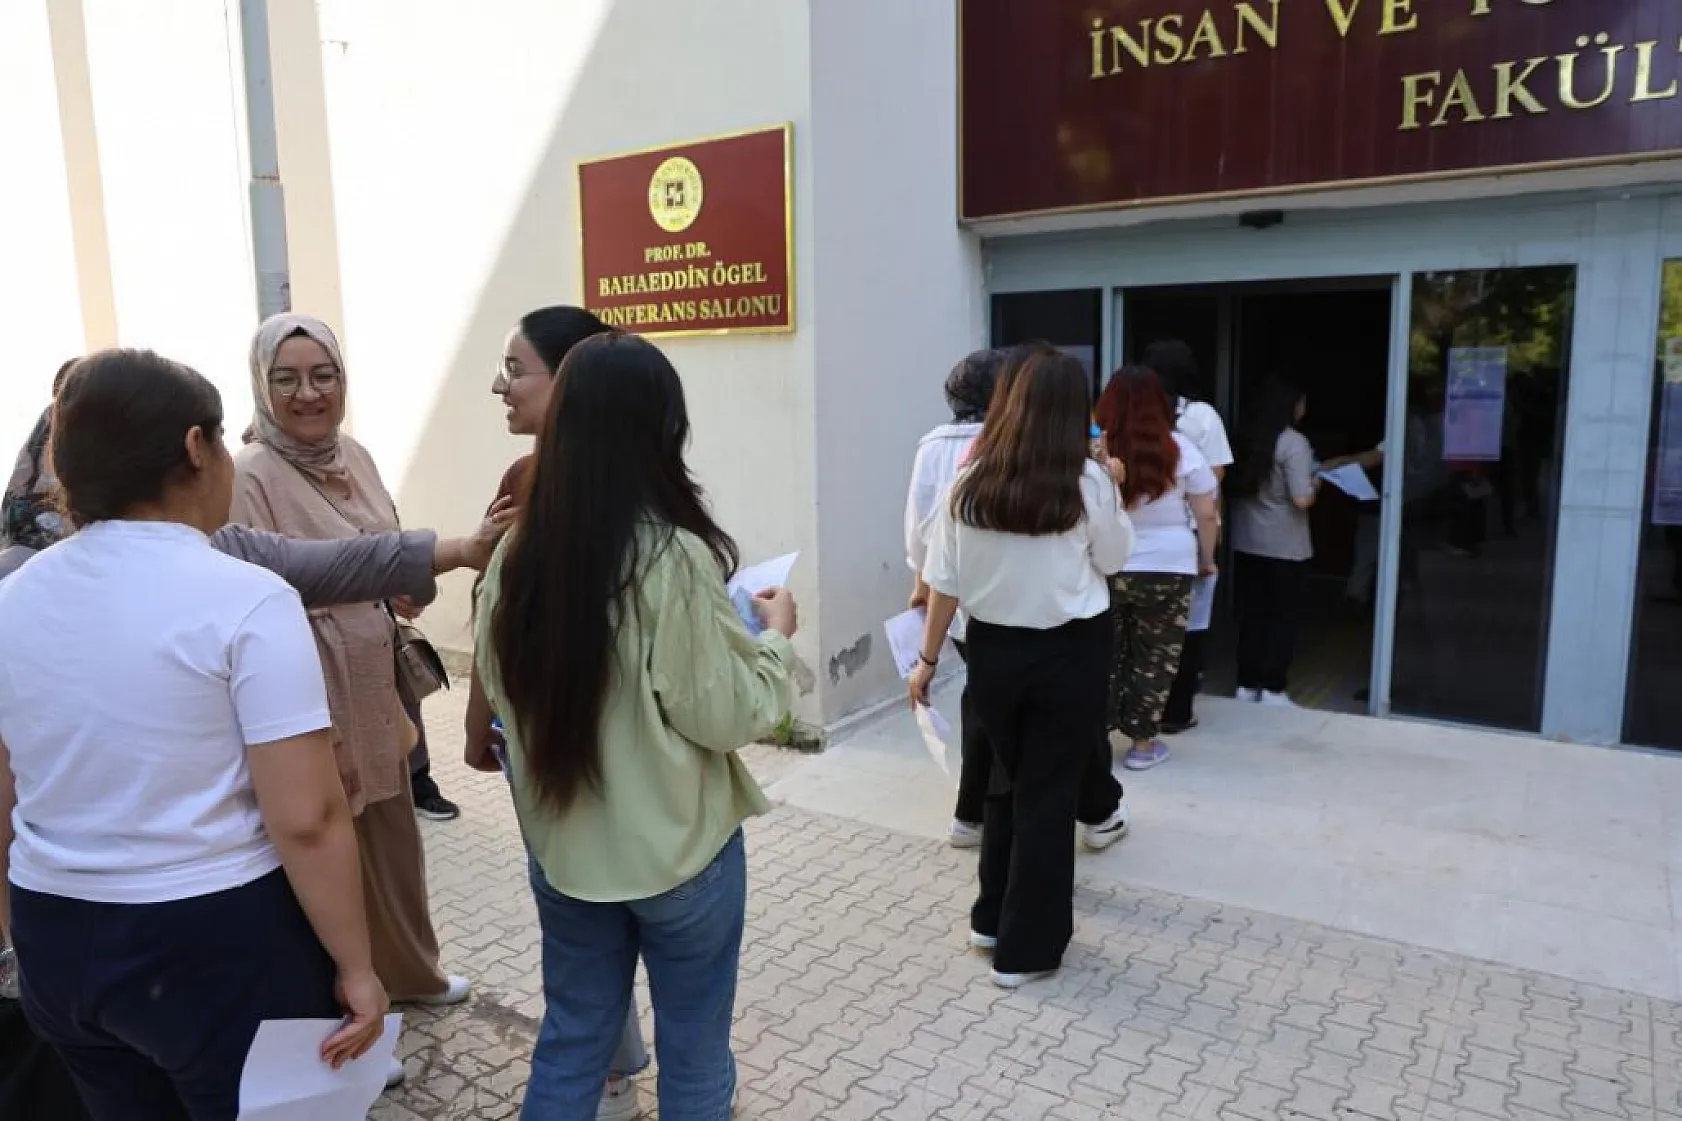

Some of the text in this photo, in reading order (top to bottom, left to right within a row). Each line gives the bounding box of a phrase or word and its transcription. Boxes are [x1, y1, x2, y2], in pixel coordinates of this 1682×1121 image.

[1089, 0, 1418, 79] İNSAN VE
[1397, 31, 1682, 131] FAKÜL
[644, 241, 711, 264] PROF. DR.
[598, 259, 767, 297] BAHAEDDİN ÖGEL
[699, 294, 782, 320] SALONU
